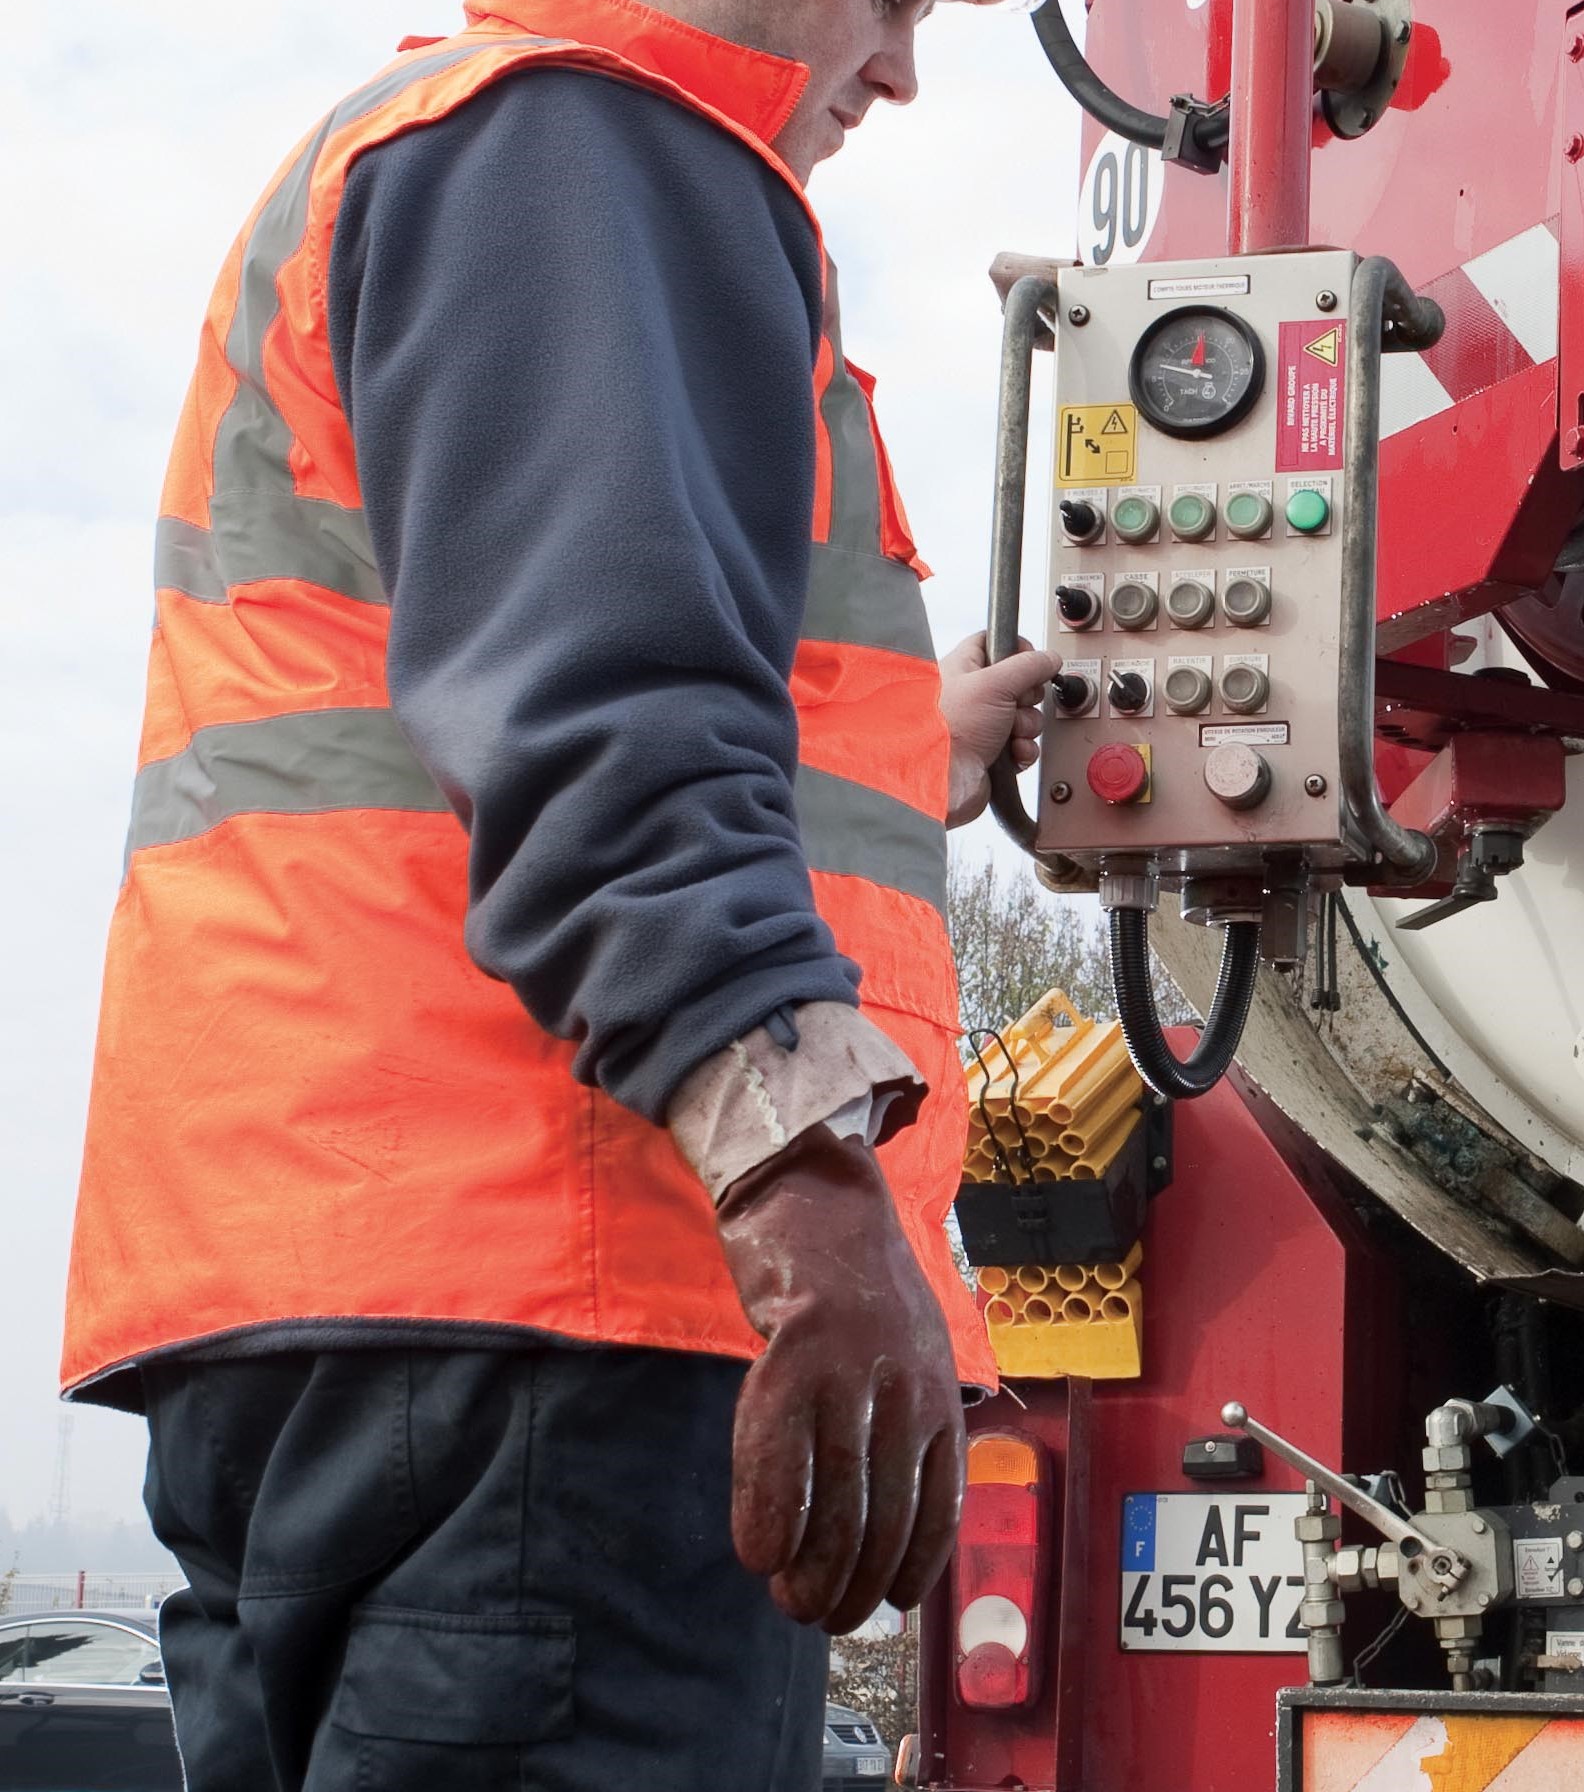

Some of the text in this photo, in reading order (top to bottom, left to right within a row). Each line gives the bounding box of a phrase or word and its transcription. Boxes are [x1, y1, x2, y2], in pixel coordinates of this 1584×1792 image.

[1092, 140, 1149, 266] 90
[1290, 480, 1328, 488] SELECTION
[1228, 569, 1266, 577] FERMETURE
[1195, 1504, 1270, 1567] AF
[1135, 1541, 1145, 1558] F
[1124, 1574, 1234, 1639] 456
[1556, 1639, 1576, 1648] Vanne
